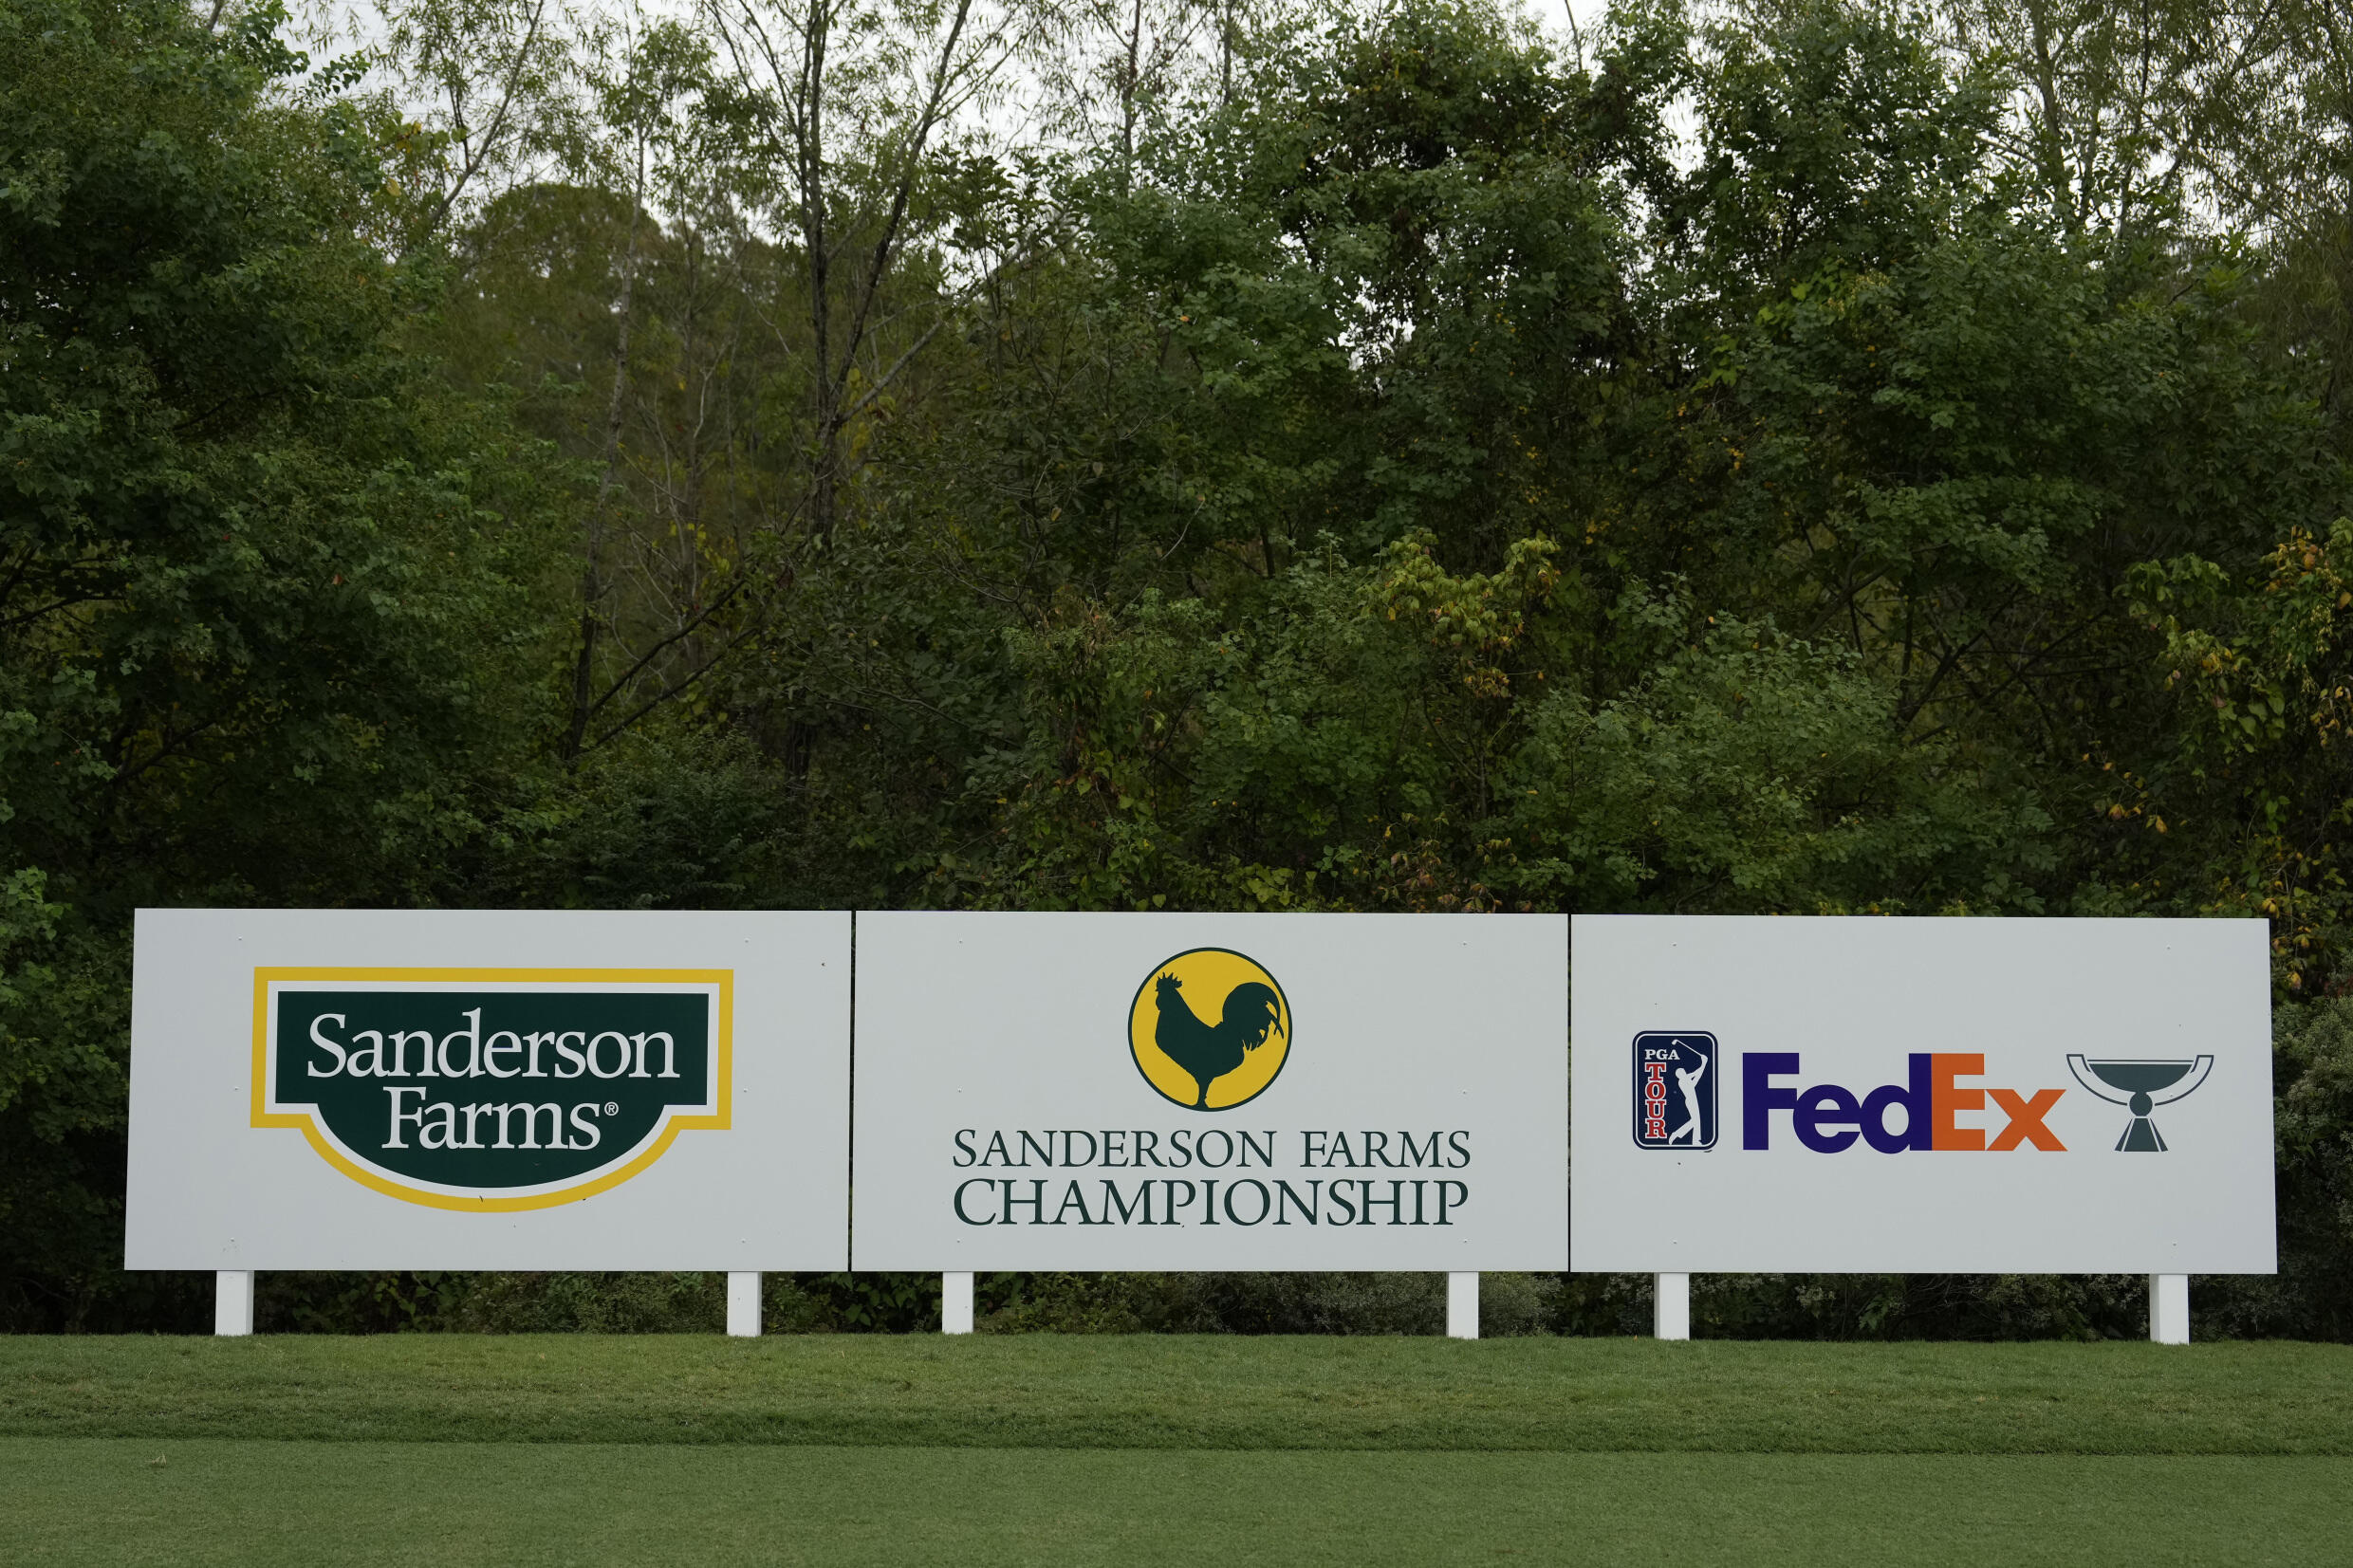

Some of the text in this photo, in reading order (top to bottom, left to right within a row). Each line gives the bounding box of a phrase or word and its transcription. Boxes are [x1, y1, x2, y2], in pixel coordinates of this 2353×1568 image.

[306, 1006, 680, 1079] Sanderson
[1644, 1048, 1680, 1061] PGA
[1644, 1061, 1667, 1138] TOUR
[1742, 1052, 2068, 1154] FedEx
[953, 1129, 1472, 1170] SANDERSON FARMS
[953, 1178, 1470, 1227] CHAMPIONSHIP
